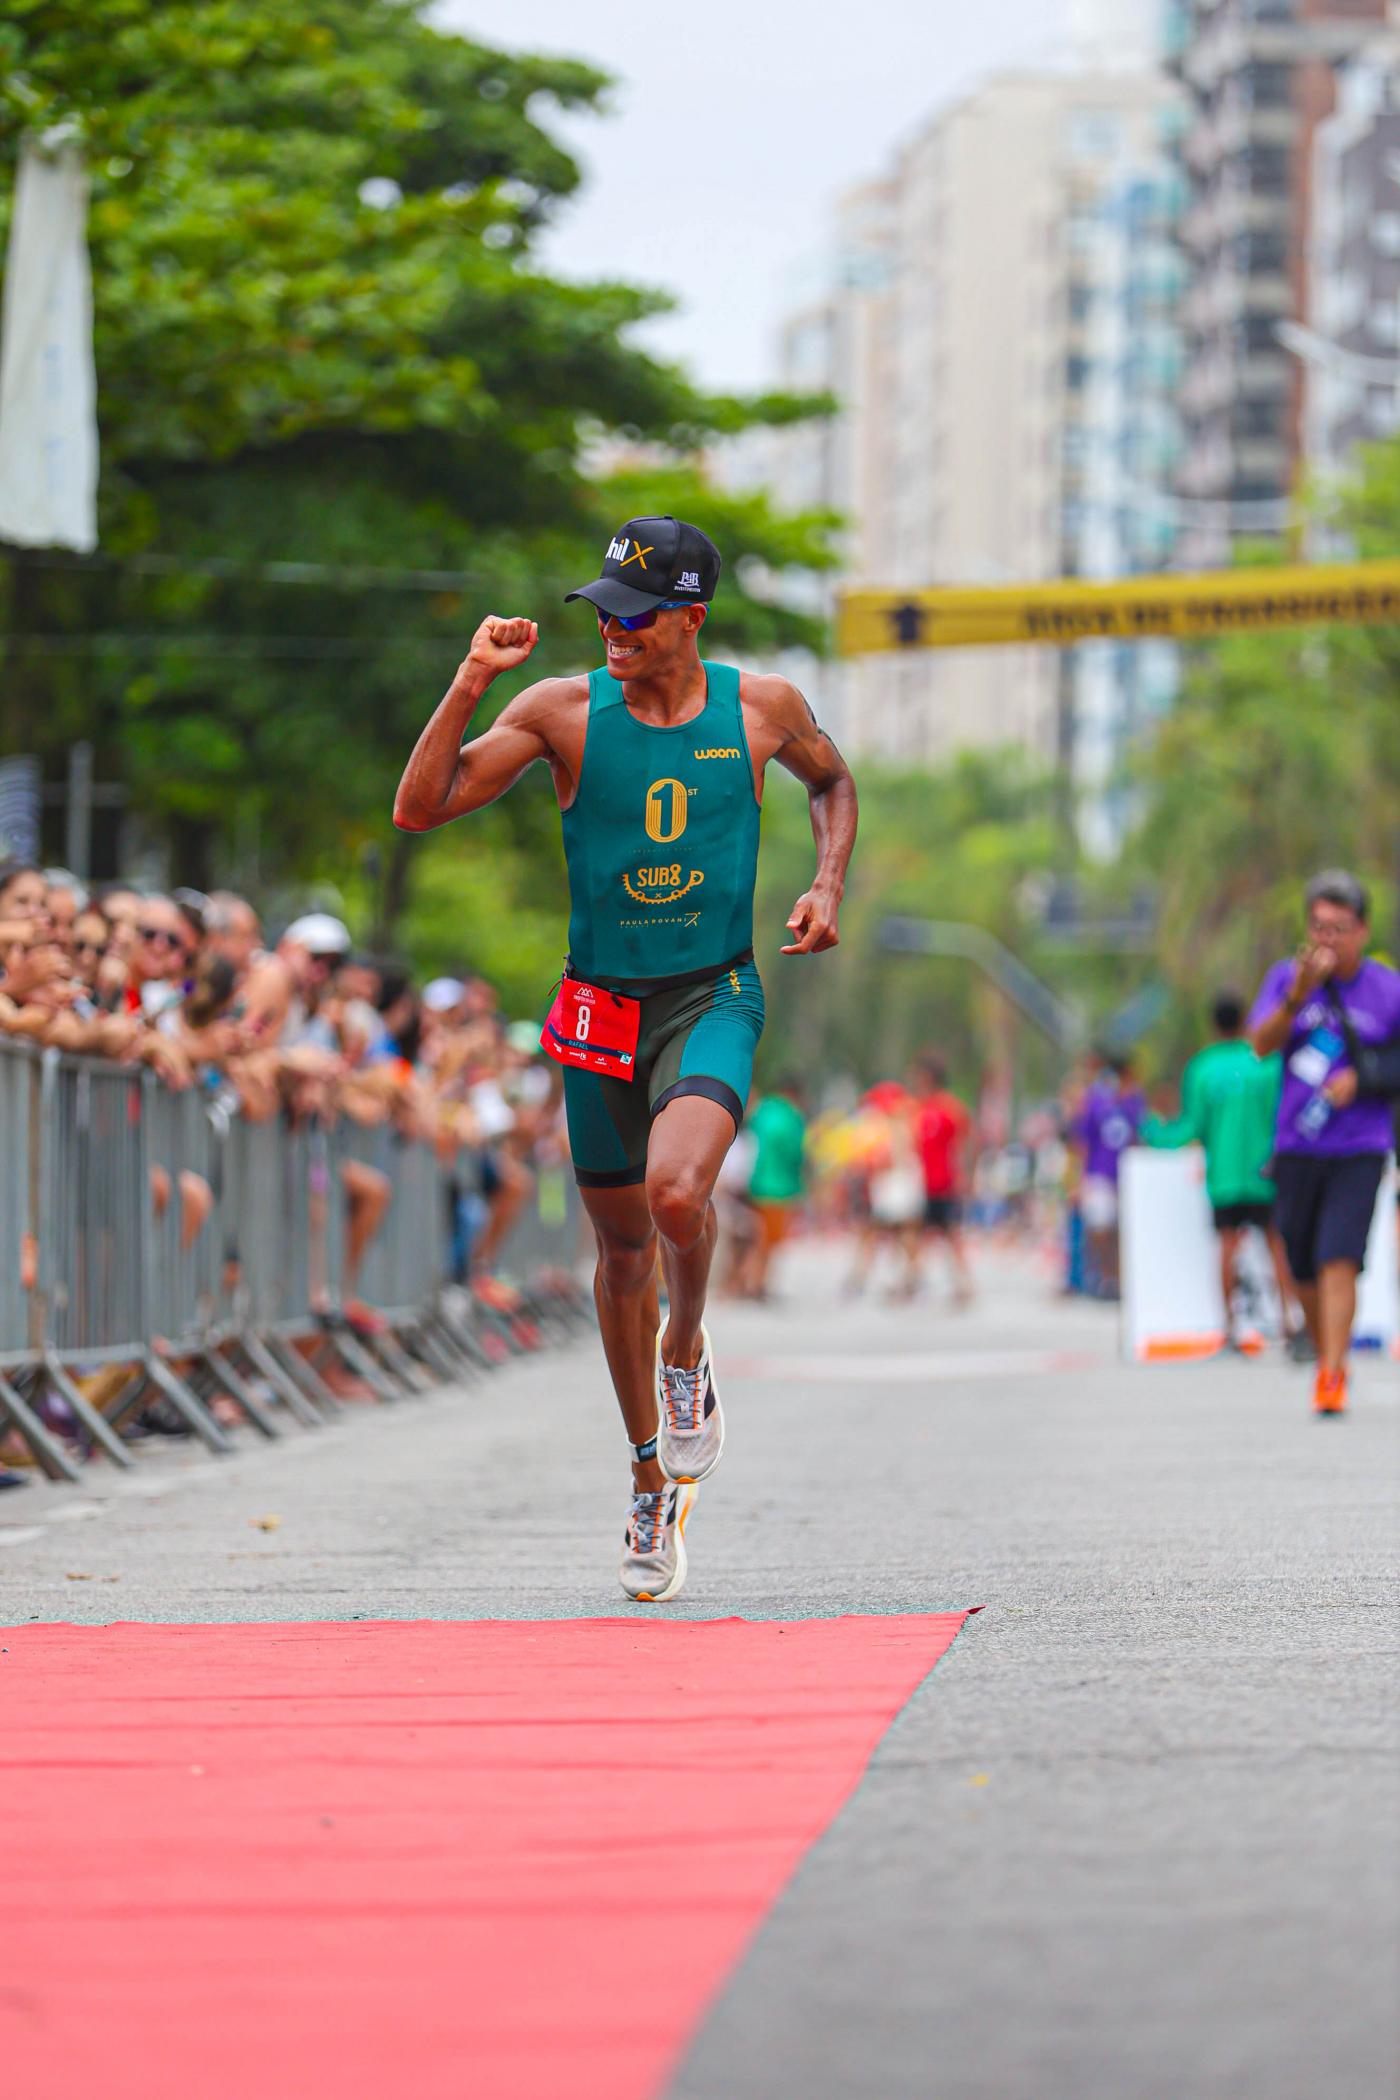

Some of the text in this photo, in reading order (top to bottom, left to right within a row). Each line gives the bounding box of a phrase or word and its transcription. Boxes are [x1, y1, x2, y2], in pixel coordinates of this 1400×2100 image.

[694, 748, 741, 760] woom
[637, 863, 682, 887] SUB8
[575, 1005, 591, 1041] 8
